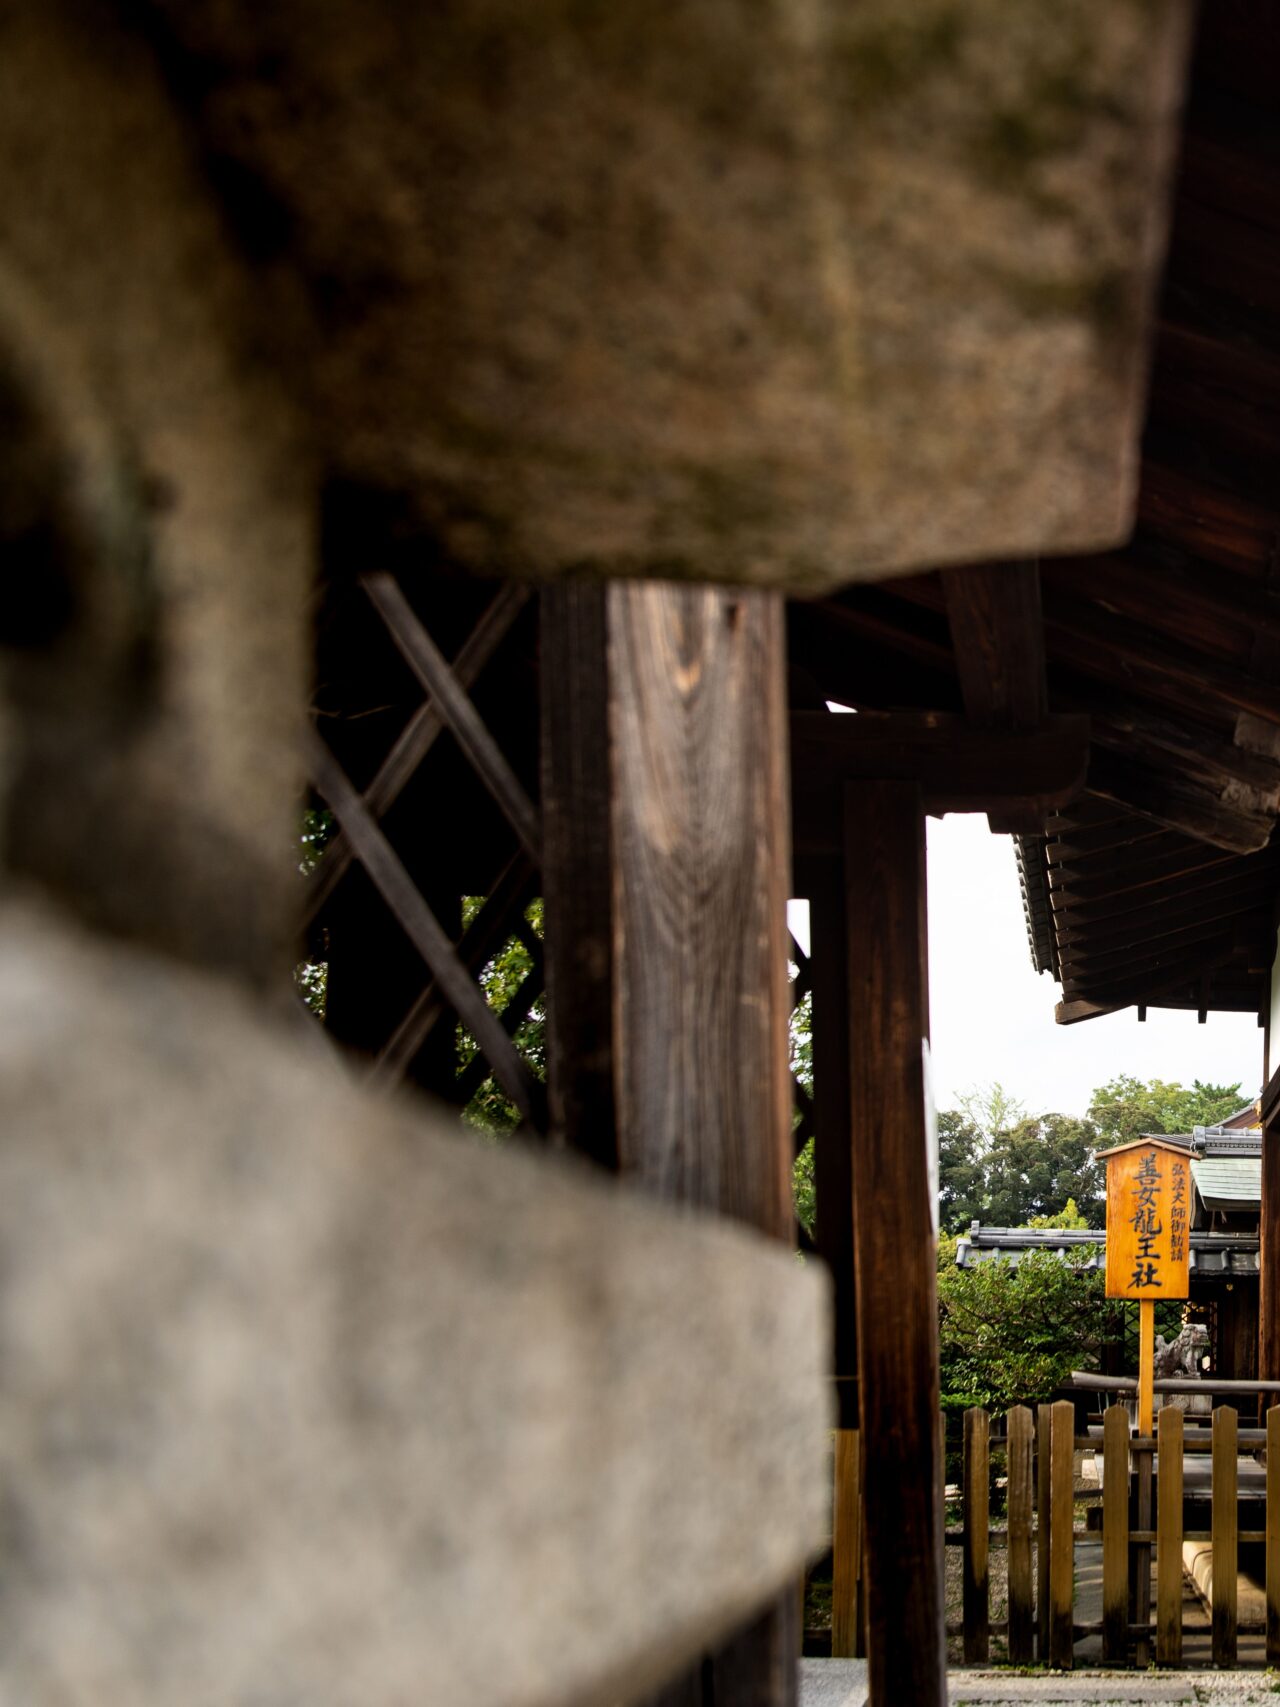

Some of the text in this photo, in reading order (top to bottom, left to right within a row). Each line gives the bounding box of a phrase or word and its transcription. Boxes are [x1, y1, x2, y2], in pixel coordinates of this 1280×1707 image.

[1127, 1152, 1163, 1288] 善女龍王社
